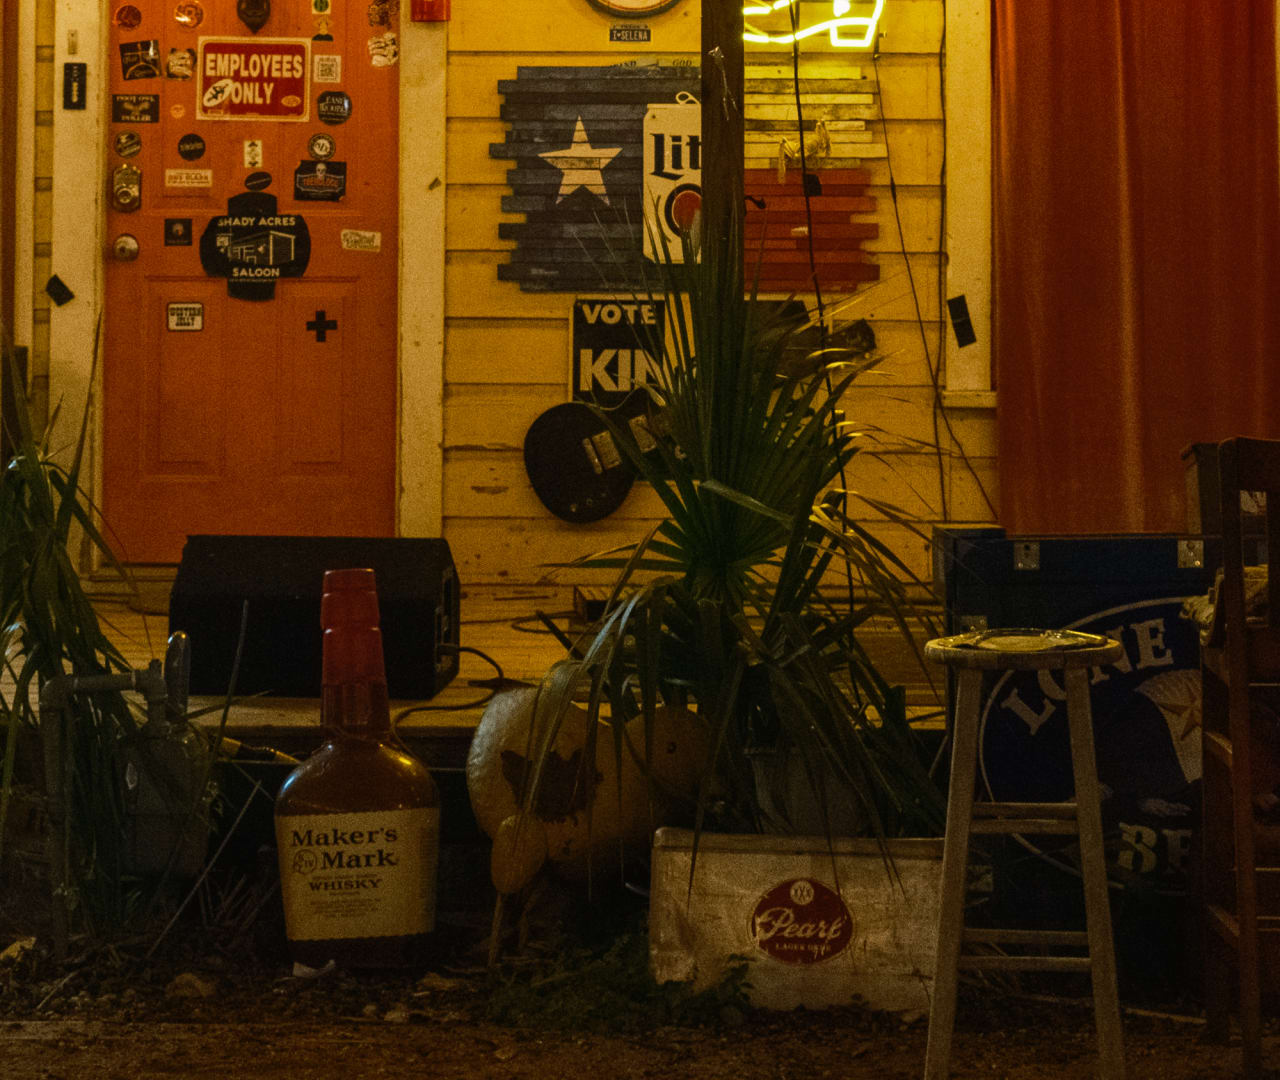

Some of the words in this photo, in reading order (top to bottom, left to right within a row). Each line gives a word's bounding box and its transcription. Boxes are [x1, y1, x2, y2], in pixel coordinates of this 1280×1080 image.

[621, 30, 649, 41] SELENA
[205, 53, 303, 78] EMPLOYEES
[231, 81, 275, 105] ONLY
[649, 132, 703, 181] Lit
[217, 216, 256, 227] SHADY
[258, 216, 297, 227] ACRES
[232, 267, 280, 278] SALOON
[581, 303, 657, 326] VOTE
[291, 828, 399, 848] Maker's
[321, 849, 399, 871] Mark
[308, 878, 383, 892] WHISKY
[754, 906, 848, 943] Pearl
